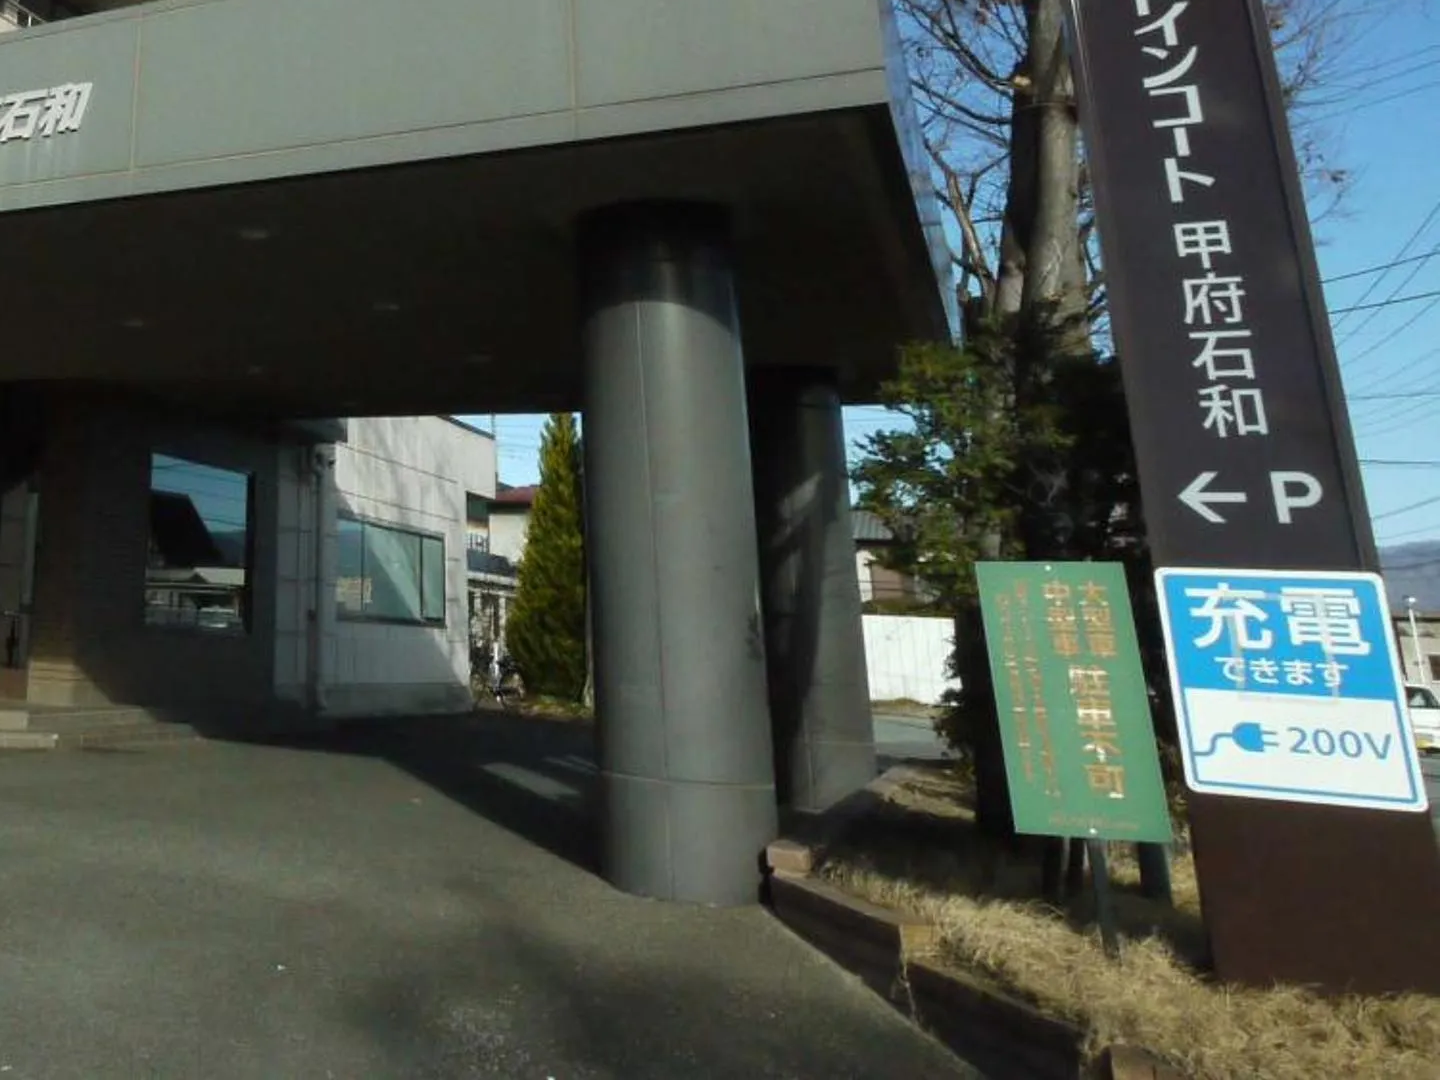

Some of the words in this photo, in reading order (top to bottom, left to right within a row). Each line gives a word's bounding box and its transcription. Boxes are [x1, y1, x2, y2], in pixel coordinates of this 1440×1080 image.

[1174, 220, 1268, 438] 甲府石和
[1271, 470, 1323, 524] P
[1184, 581, 1372, 657] 充電
[1213, 655, 1350, 687] できます
[1287, 726, 1393, 761] 200V
